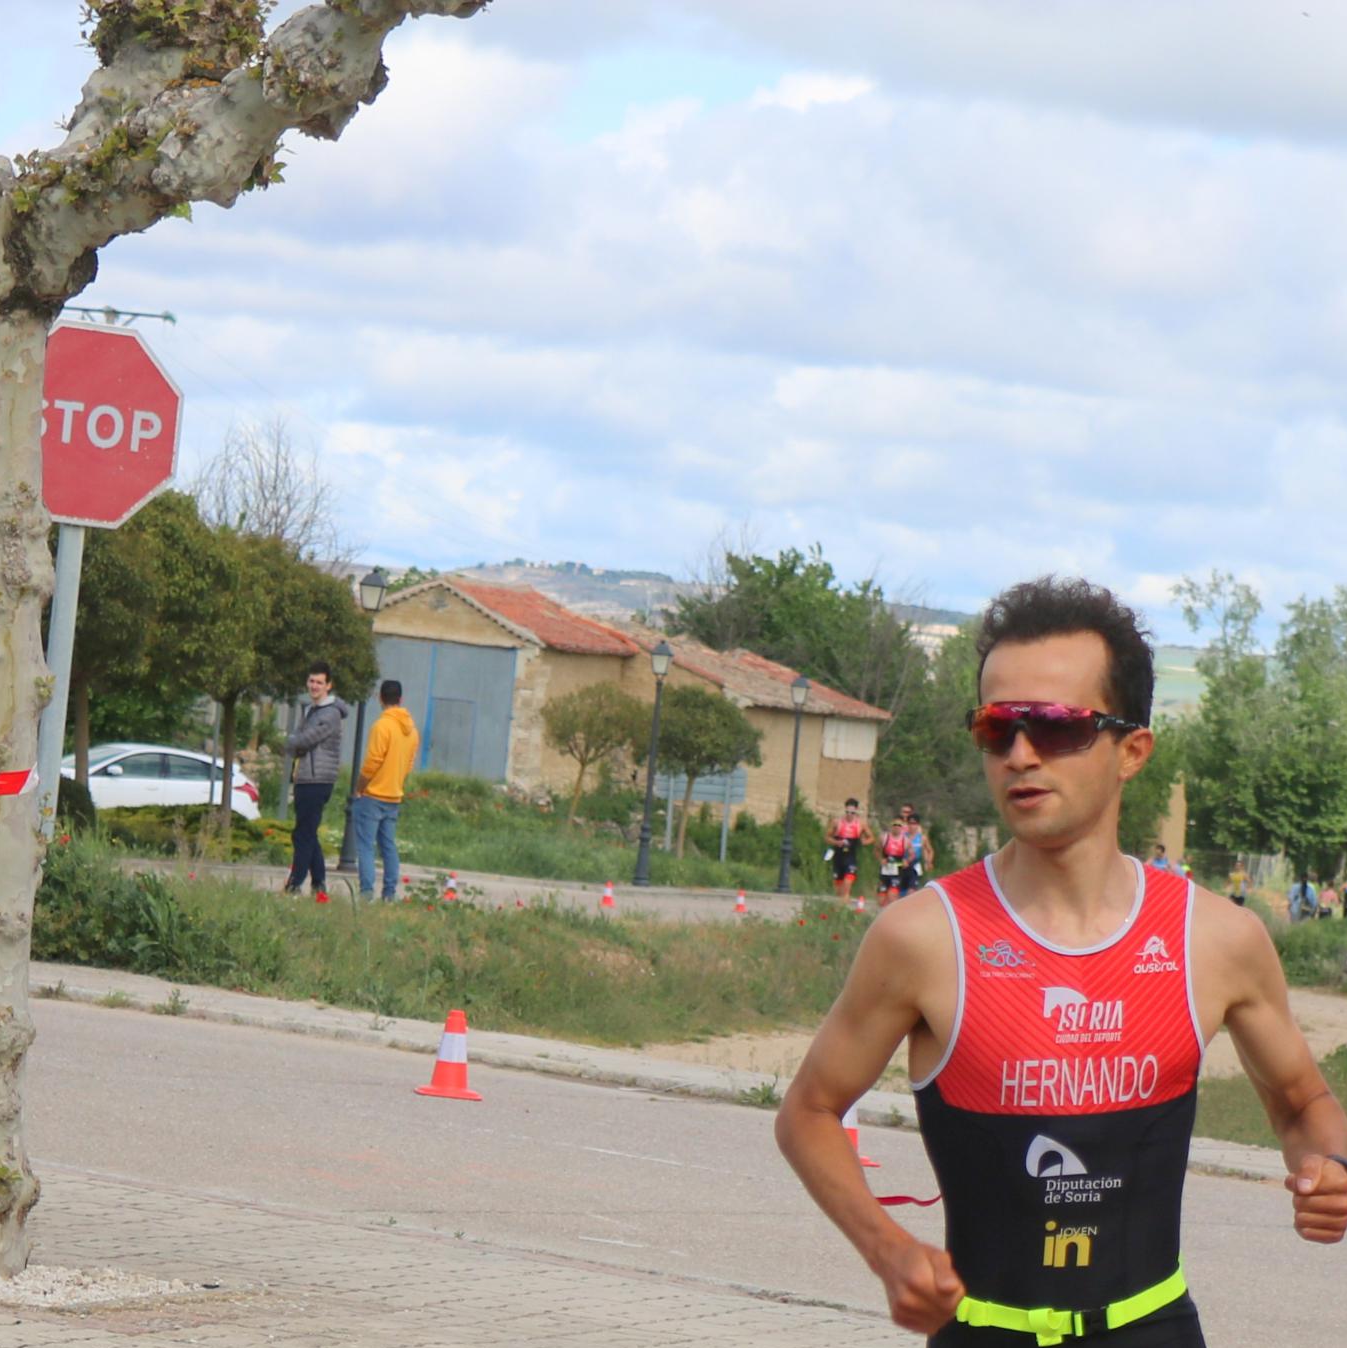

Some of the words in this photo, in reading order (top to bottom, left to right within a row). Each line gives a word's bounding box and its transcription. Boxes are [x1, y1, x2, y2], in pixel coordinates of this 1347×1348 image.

[41, 399, 162, 453] TOP
[1000, 1054, 1159, 1107] HERNANDO
[1044, 1191, 1061, 1204] de
[1064, 1189, 1101, 1203] Soria
[1046, 1176, 1122, 1194] Diputación
[1042, 1221, 1090, 1268] in
[1059, 1226, 1098, 1239] JOVEN
